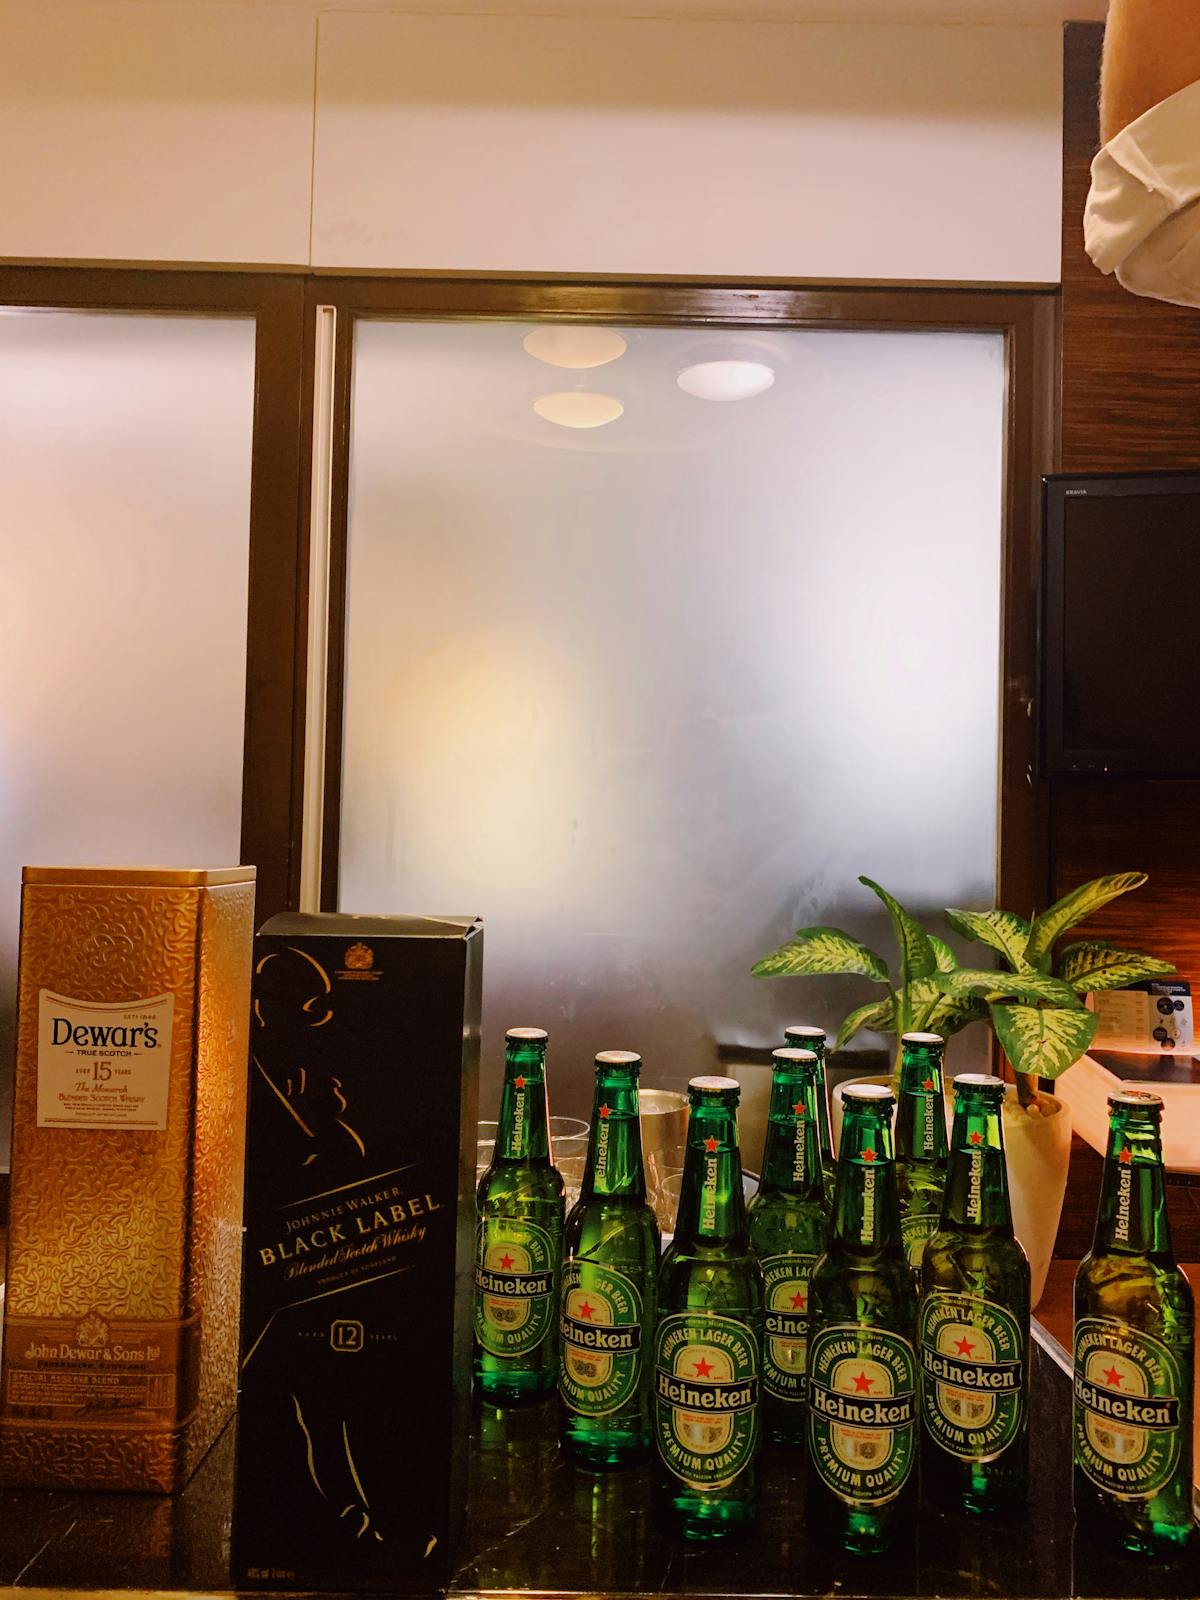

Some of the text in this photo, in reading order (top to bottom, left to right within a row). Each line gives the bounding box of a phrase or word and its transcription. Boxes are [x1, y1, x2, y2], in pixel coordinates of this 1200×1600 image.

[51, 1017, 159, 1048] Dewar's
[92, 1061, 112, 1081] 15
[511, 1092, 525, 1151] Heineken
[924, 1094, 934, 1150] Heineken
[596, 1122, 610, 1178] eineken
[792, 1120, 806, 1182] Heineken
[861, 1168, 875, 1242] Heineken
[967, 1150, 982, 1217] Heineken
[1115, 1168, 1132, 1241] Heineken
[259, 1194, 441, 1266] BLACK LABEL
[286, 1187, 401, 1232] JOHNNIE WALKER
[284, 1249, 340, 1281] Blended
[529, 1240, 545, 1263] BEER
[475, 1267, 547, 1295] Heineken
[594, 1278, 613, 1295] GER
[611, 1290, 628, 1314] BEER
[337, 1326, 358, 1345] 12
[507, 1314, 541, 1344] QUALITY
[662, 1327, 748, 1369] HEINEKEN LAGER BEER
[926, 1306, 1010, 1351] HEINEKEN LAGER BEER
[25, 1342, 58, 1360] John
[60, 1343, 101, 1361] Dewar
[103, 1350, 112, 1361] &
[113, 1346, 145, 1361] Sons
[818, 1341, 908, 1382] HEINEKEN LAGER BEER
[923, 1349, 1015, 1388] Heineken
[1077, 1332, 1164, 1387] HEINEKEN LAGER BEER
[588, 1370, 626, 1402] QUALITY
[658, 1374, 751, 1409] Heineken
[814, 1387, 910, 1424] Heineken
[1074, 1375, 1170, 1424] Heineken
[926, 1394, 1009, 1446] PREMIUM QUALITY
[661, 1422, 747, 1471] PREMIUM QUALITY
[818, 1437, 905, 1488] PREMIUM QUALITY
[1076, 1423, 1113, 1477] PREMIUM
[1117, 1448, 1164, 1482] QUALITY
